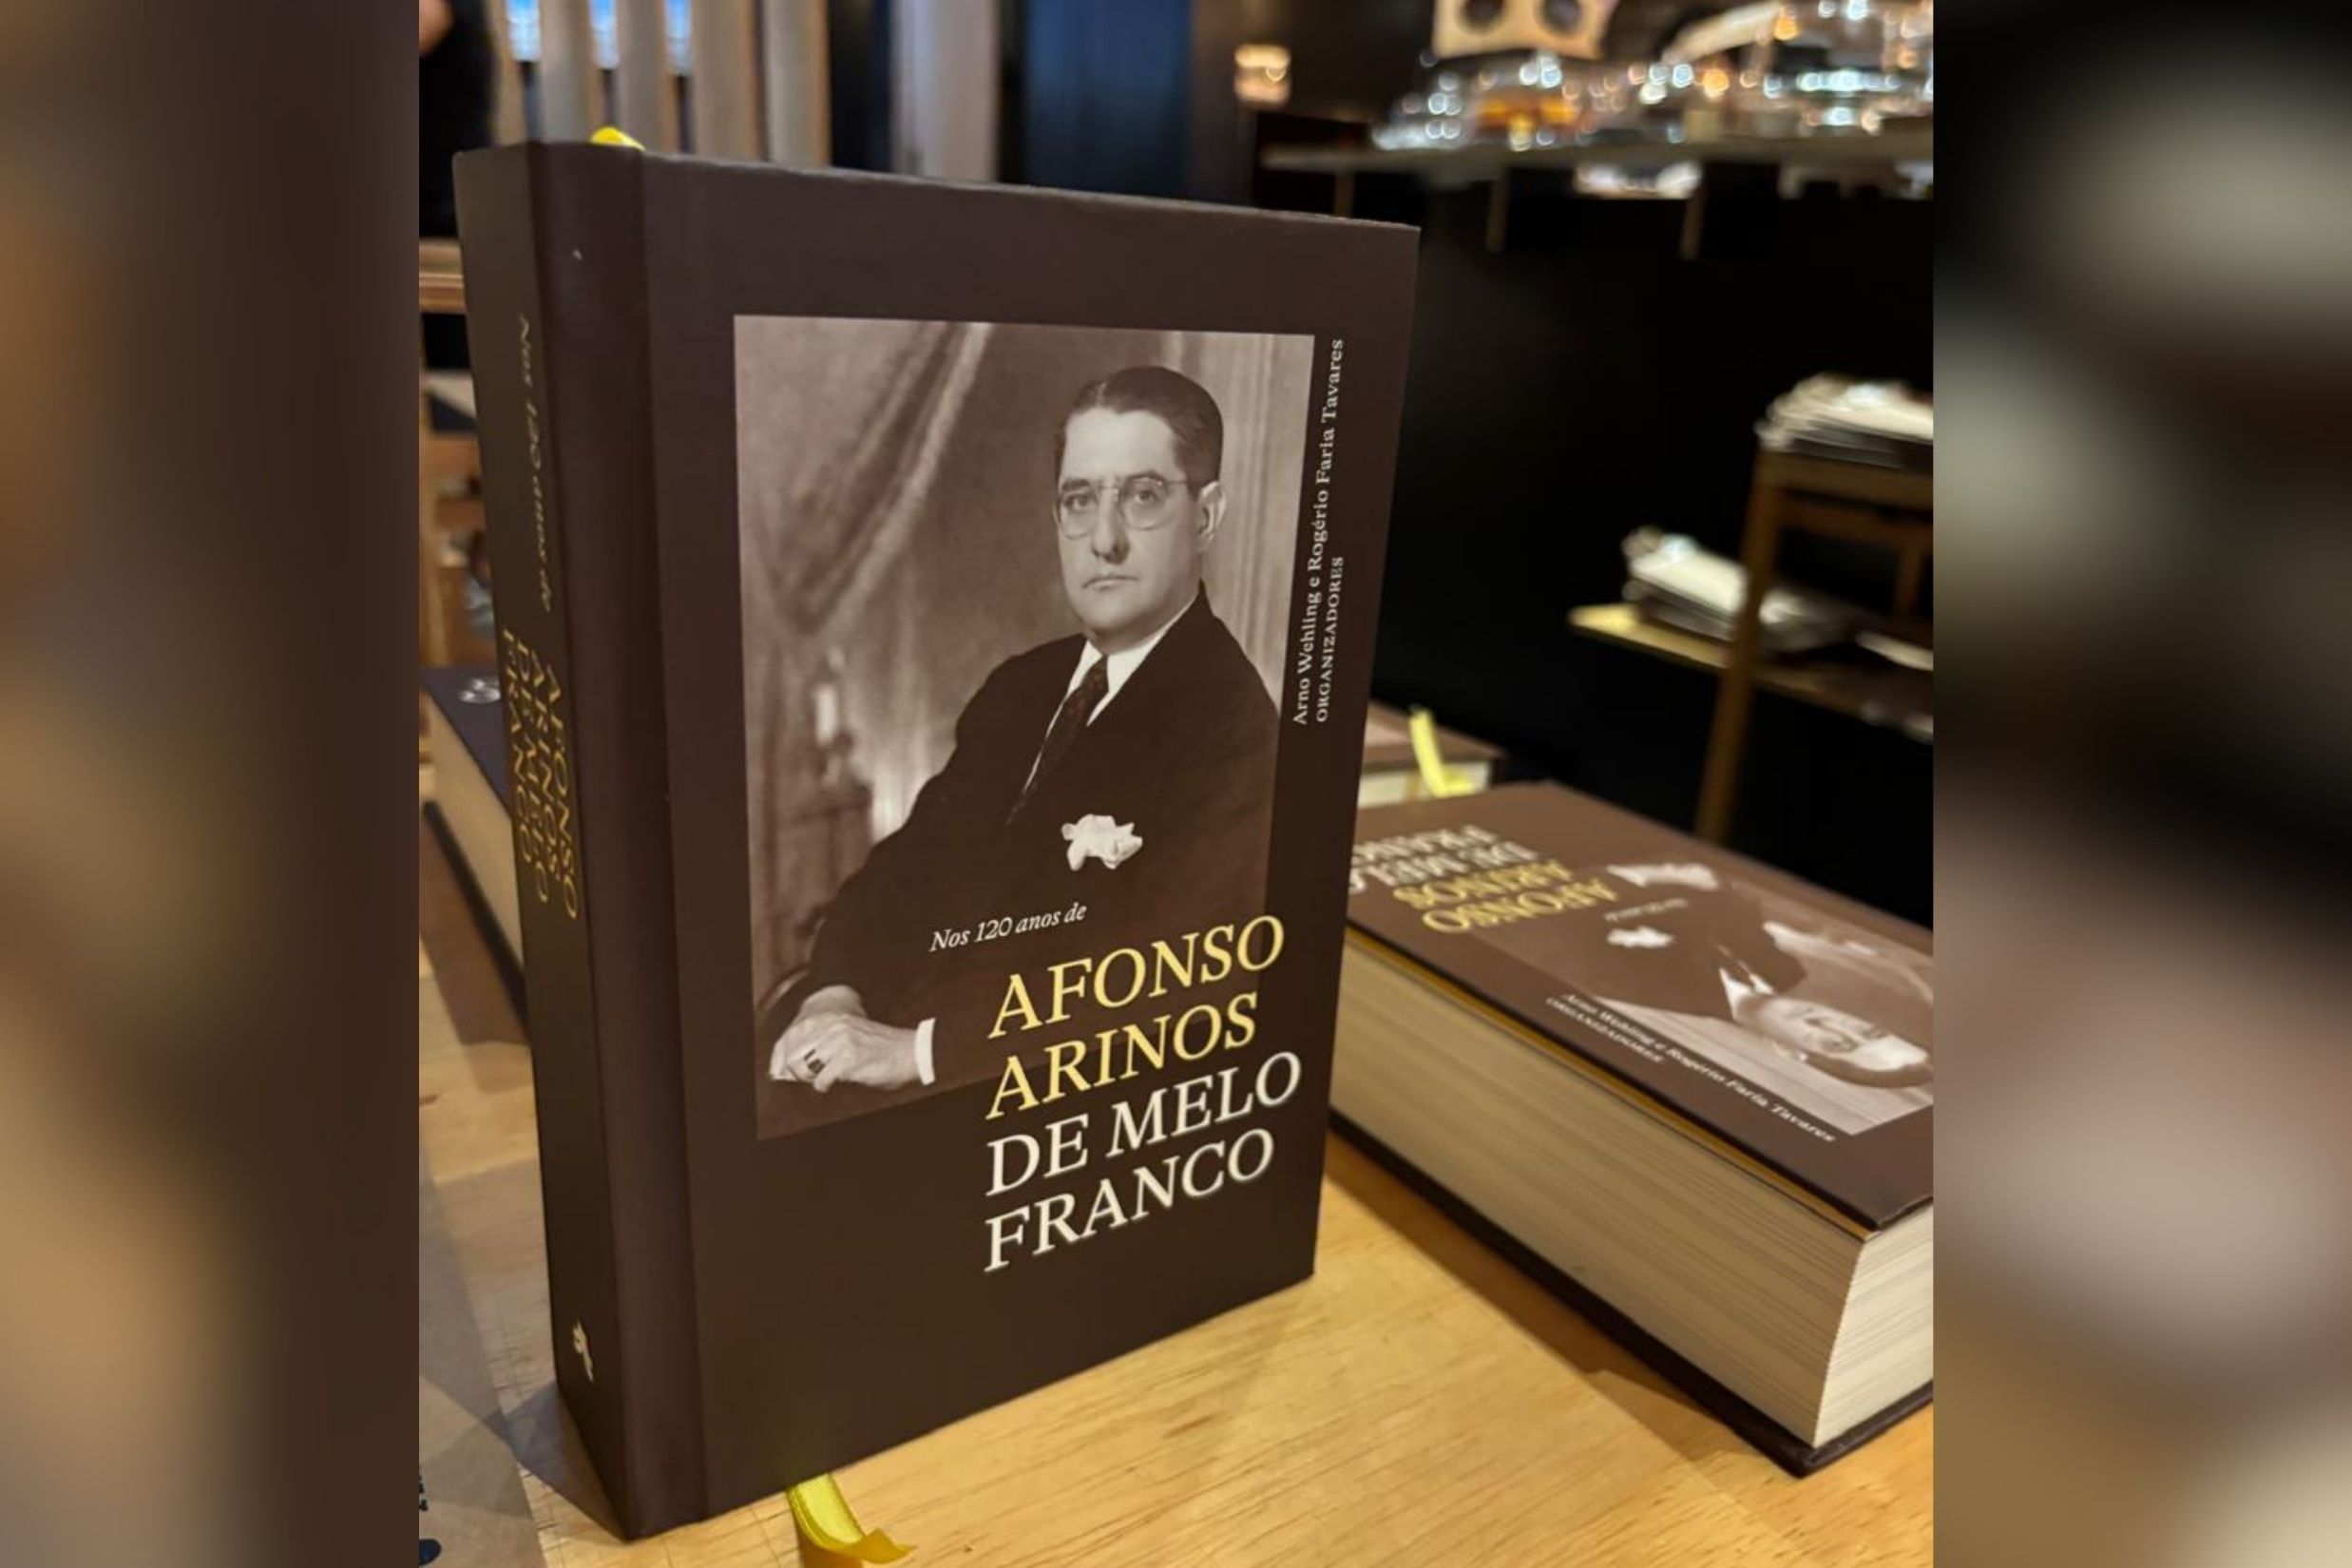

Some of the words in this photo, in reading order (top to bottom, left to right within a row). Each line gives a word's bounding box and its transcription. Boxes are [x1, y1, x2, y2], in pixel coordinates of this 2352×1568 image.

[1321, 338, 1344, 423] Tavares
[1315, 427, 1334, 485] Faria
[1308, 488, 1329, 571] Rogério
[1310, 576, 1319, 586] e
[1297, 591, 1320, 674] Wehling
[1316, 556, 1344, 722] ORGANIZADORES
[1292, 677, 1310, 725] Arno
[929, 928, 969, 952] Nos
[975, 917, 1012, 944] 120
[1016, 910, 1061, 934] anos
[1064, 902, 1087, 922] de
[987, 915, 1284, 1039] AFONSO
[985, 992, 1257, 1119] ARINOS
[985, 1114, 1089, 1197] DE
[1106, 1051, 1302, 1158] MELO
[984, 1128, 1274, 1272] FRANCO
